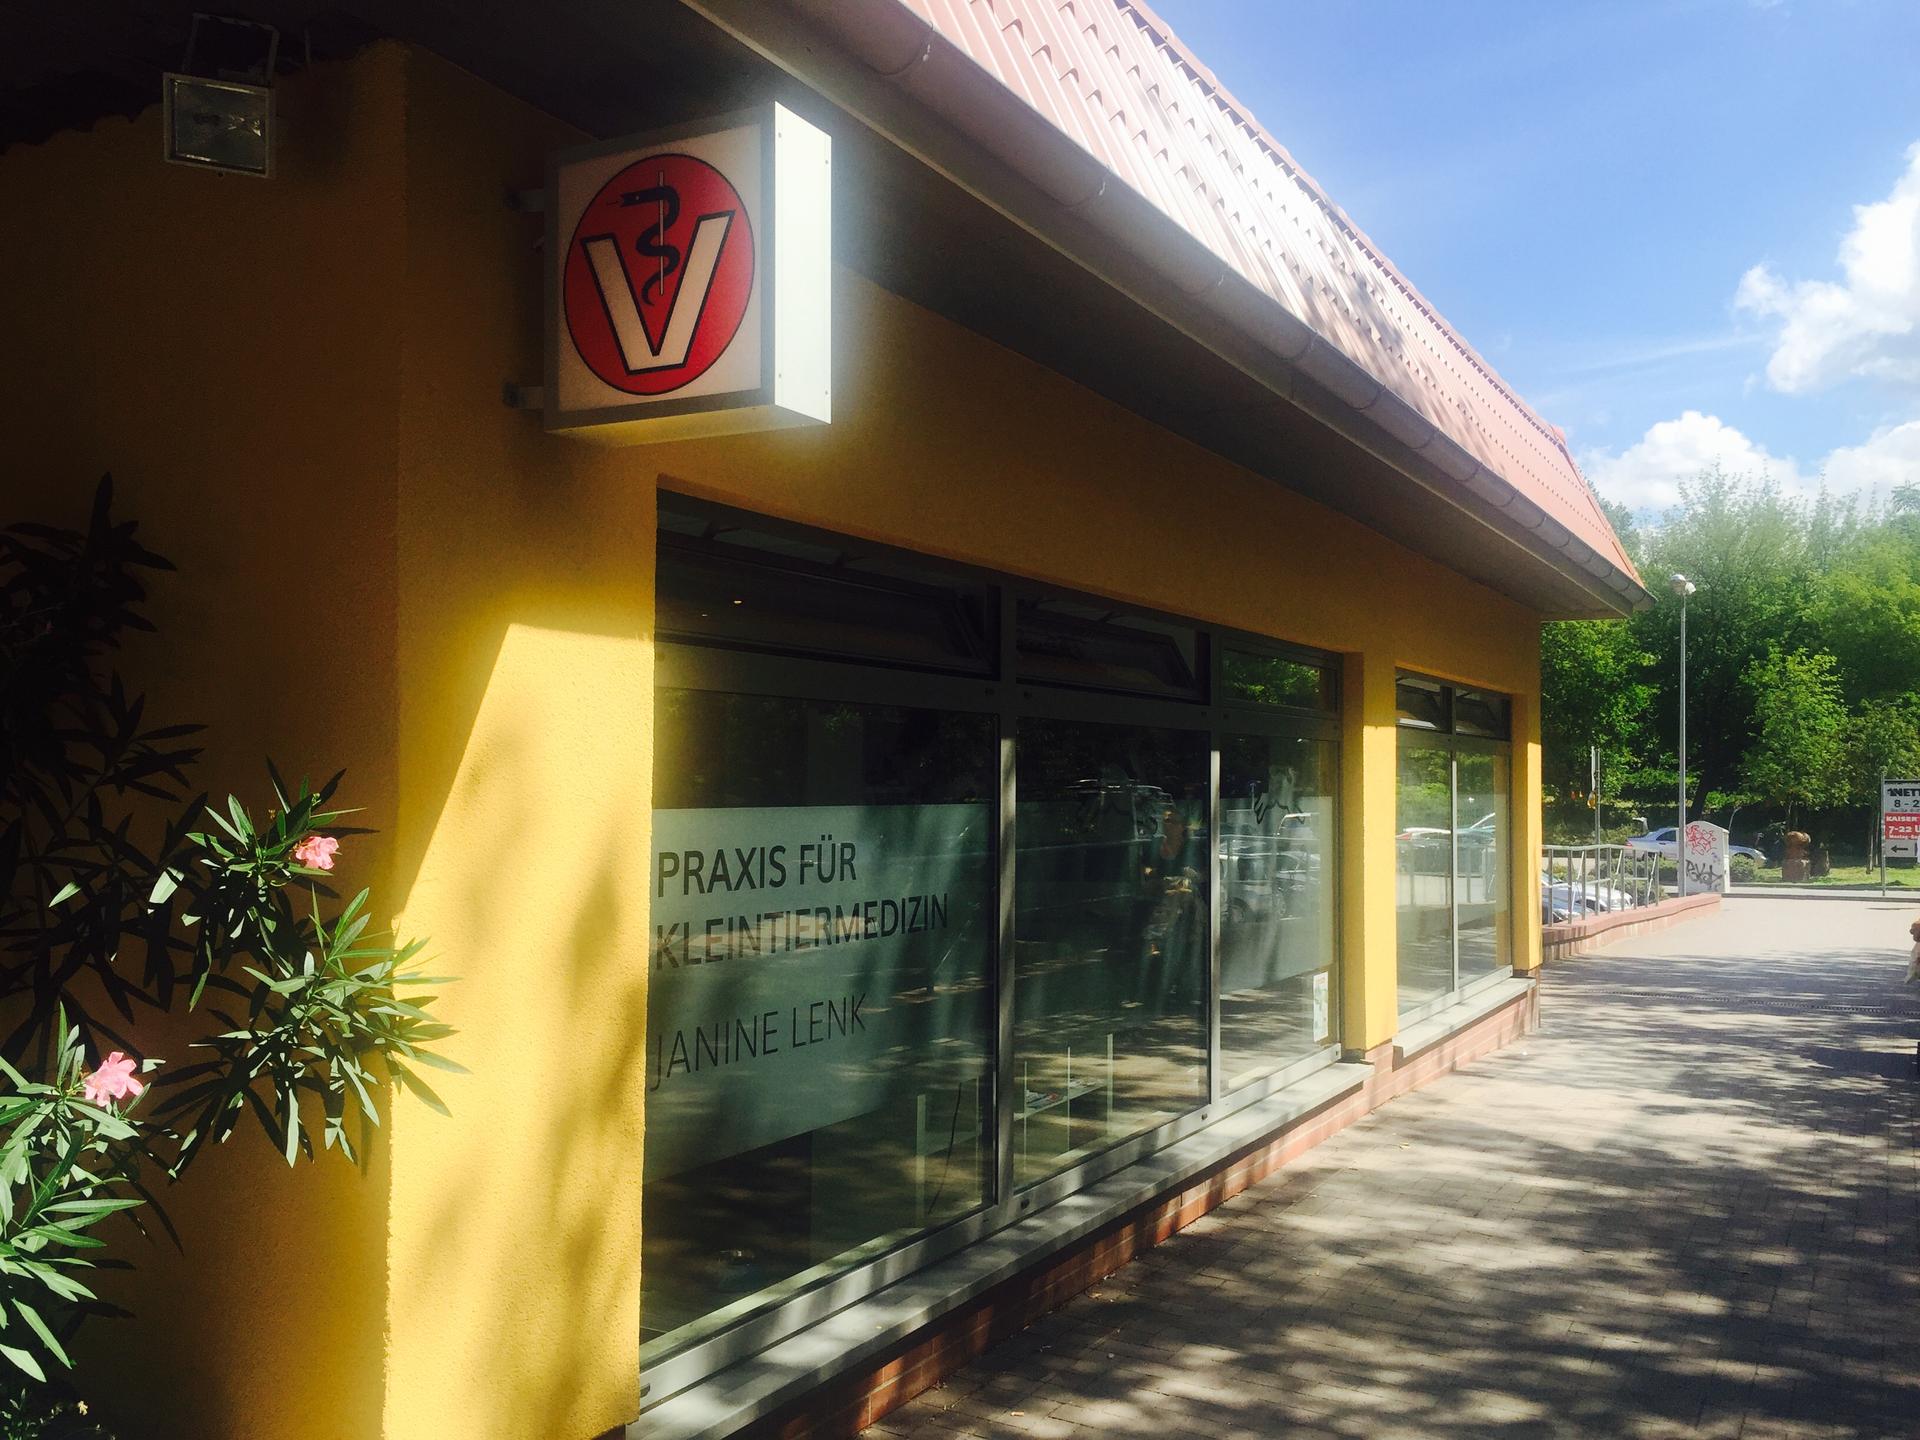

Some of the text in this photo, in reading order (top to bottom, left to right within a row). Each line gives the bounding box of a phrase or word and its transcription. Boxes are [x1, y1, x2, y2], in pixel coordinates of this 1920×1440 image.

[580, 209, 736, 376] V
[1888, 826, 1912, 834] 7-22
[1894, 800, 1901, 808] 8
[657, 834, 857, 898] PRAXIS FÜR
[656, 893, 949, 970] KLEINTIERMEDIZIN
[649, 993, 867, 1092] JANINE LENK
